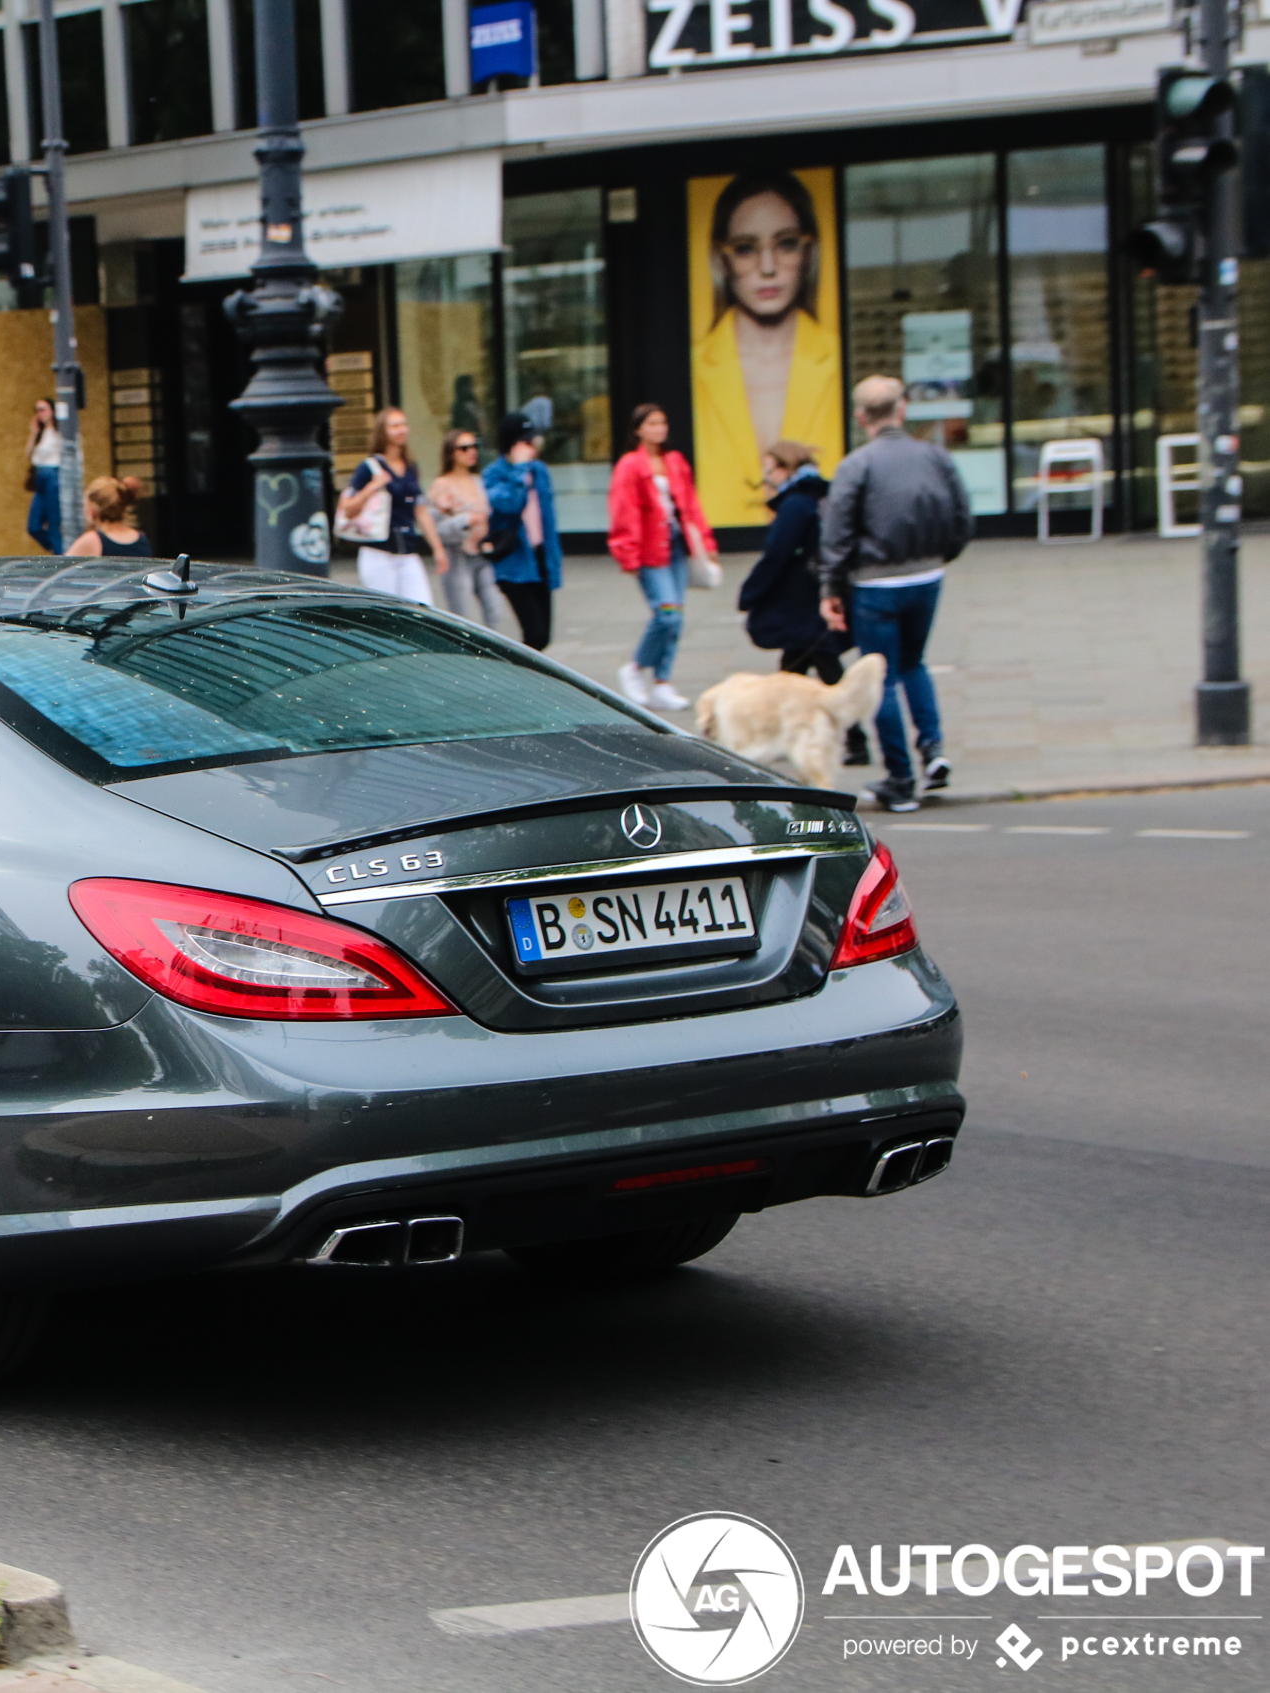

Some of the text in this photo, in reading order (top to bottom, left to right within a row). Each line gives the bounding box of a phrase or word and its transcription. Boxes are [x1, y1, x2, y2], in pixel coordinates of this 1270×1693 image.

[648, 0, 917, 68] ZEISS
[325, 850, 444, 884] CLS 63
[536, 884, 747, 951] B SN 4411
